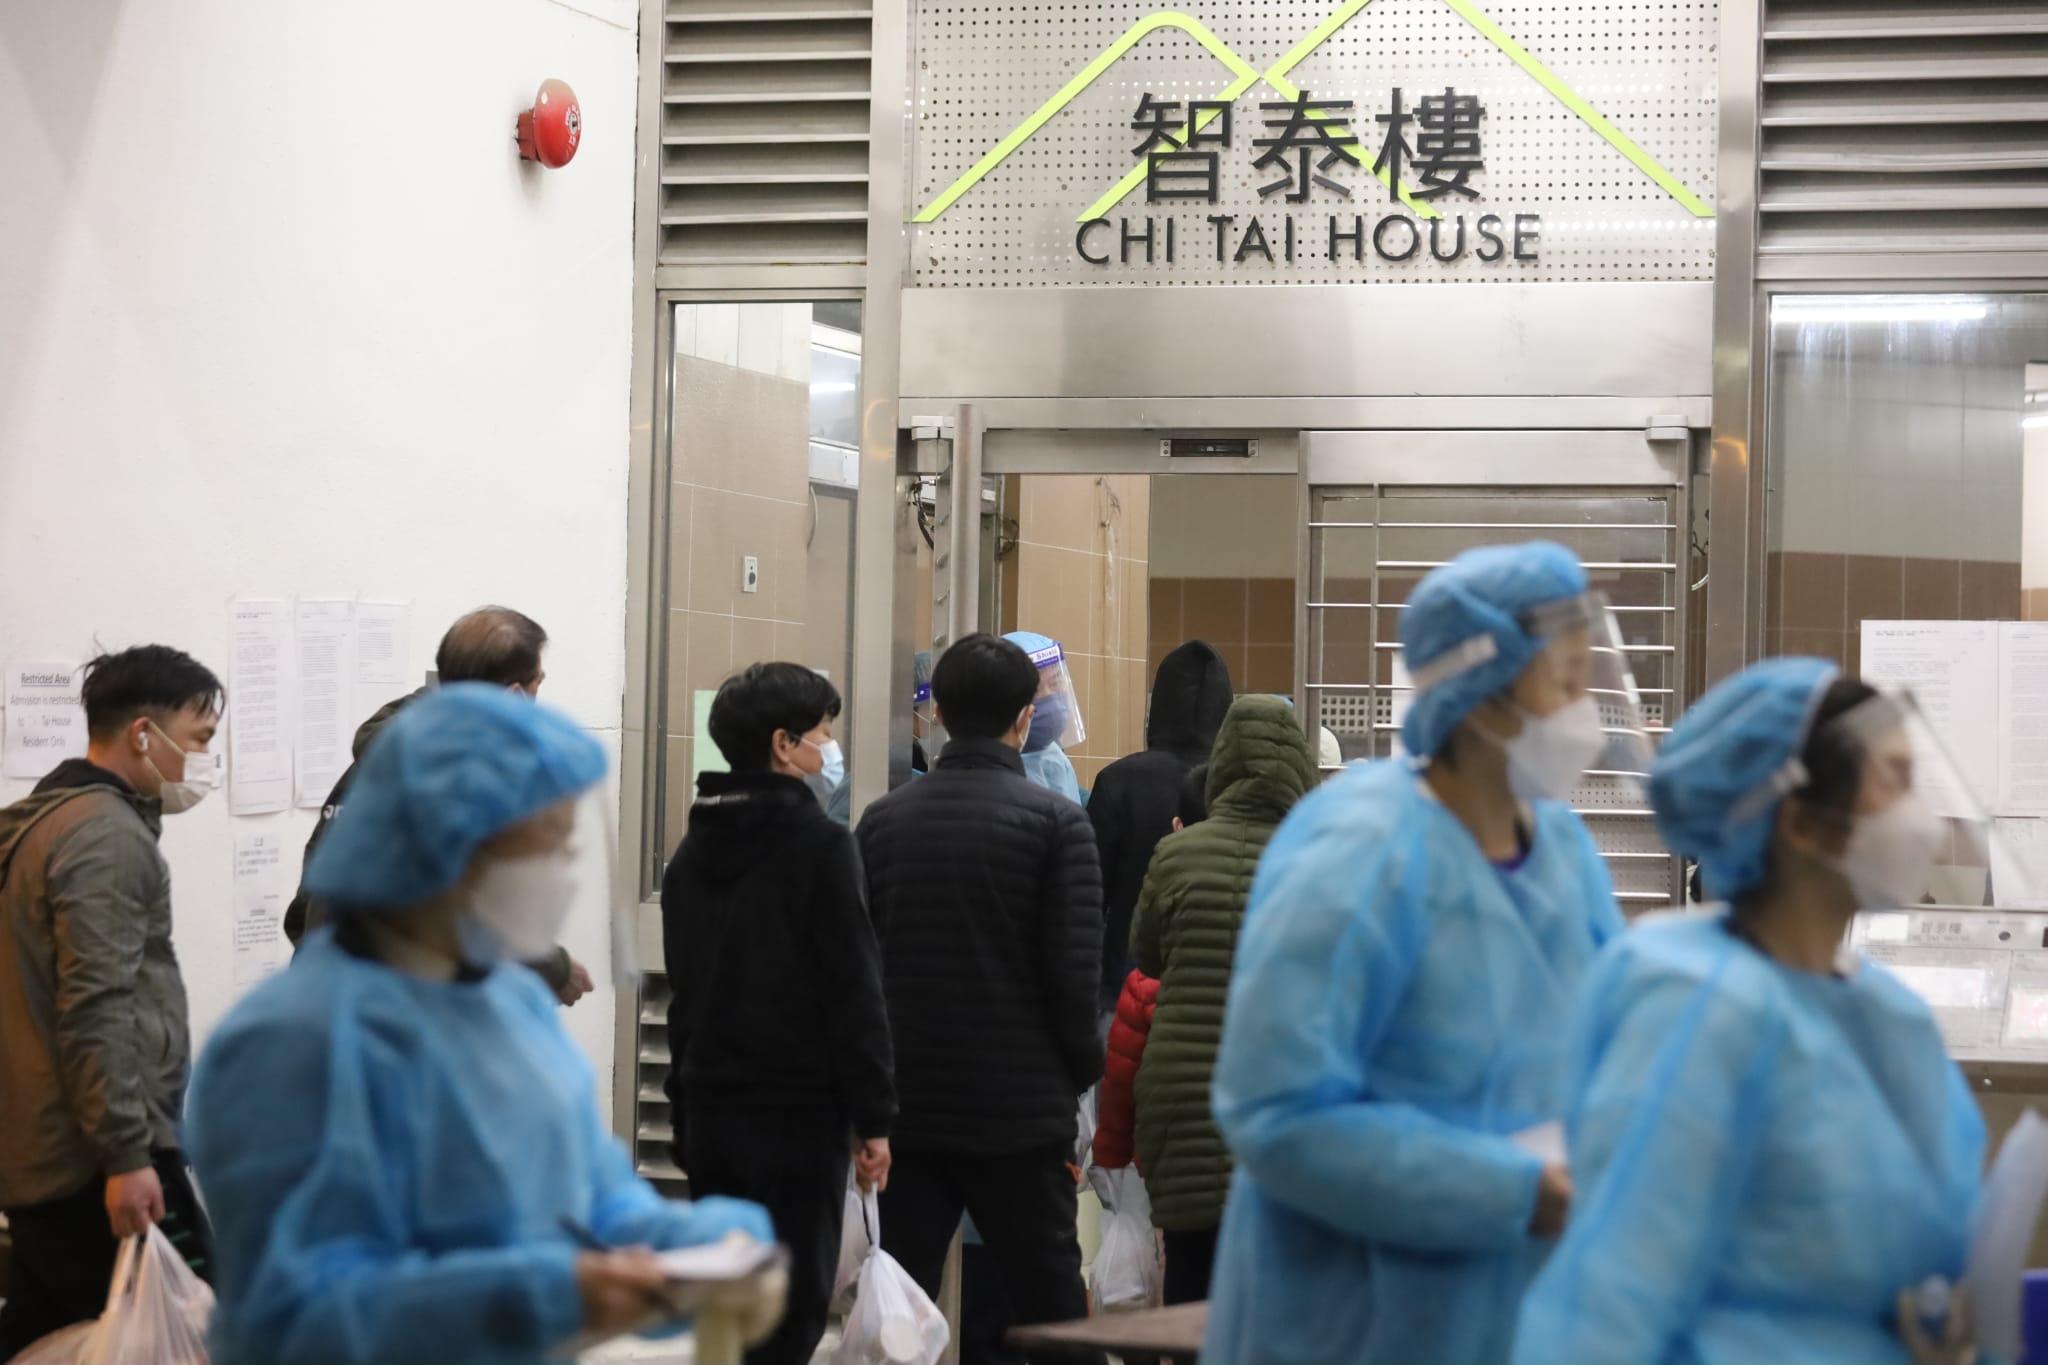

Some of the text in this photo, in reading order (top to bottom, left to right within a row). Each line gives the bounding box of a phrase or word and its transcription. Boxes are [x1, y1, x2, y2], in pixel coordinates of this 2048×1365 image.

[1130, 86, 1485, 203] 智泰樓
[1075, 213, 1540, 264] CHI TAI HOUSE
[21, 672, 71, 685] Restricted Area
